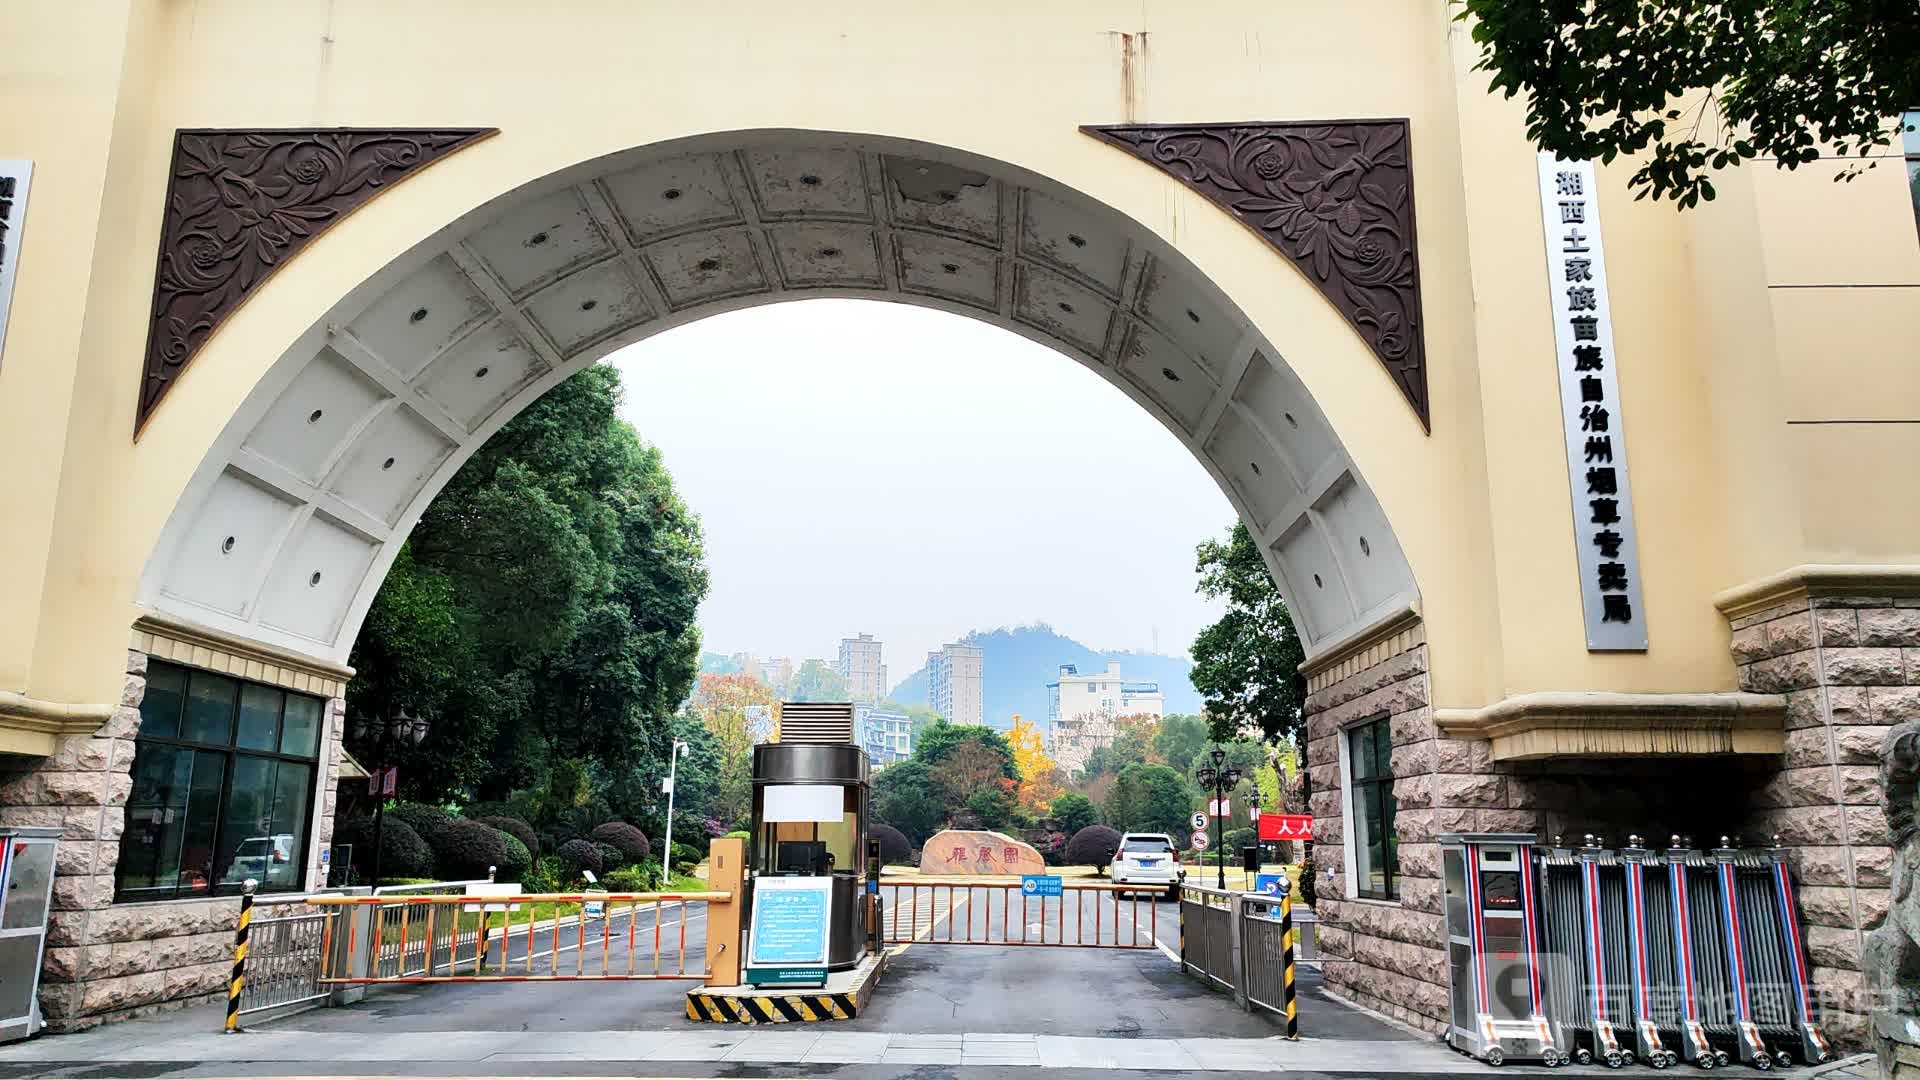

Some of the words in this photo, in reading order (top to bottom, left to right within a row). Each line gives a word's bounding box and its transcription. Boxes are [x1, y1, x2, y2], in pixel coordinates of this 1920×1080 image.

[1556, 171, 1632, 624] 湘西土家族苗族自治州烟草专卖局
[1196, 815, 1204, 827] 5
